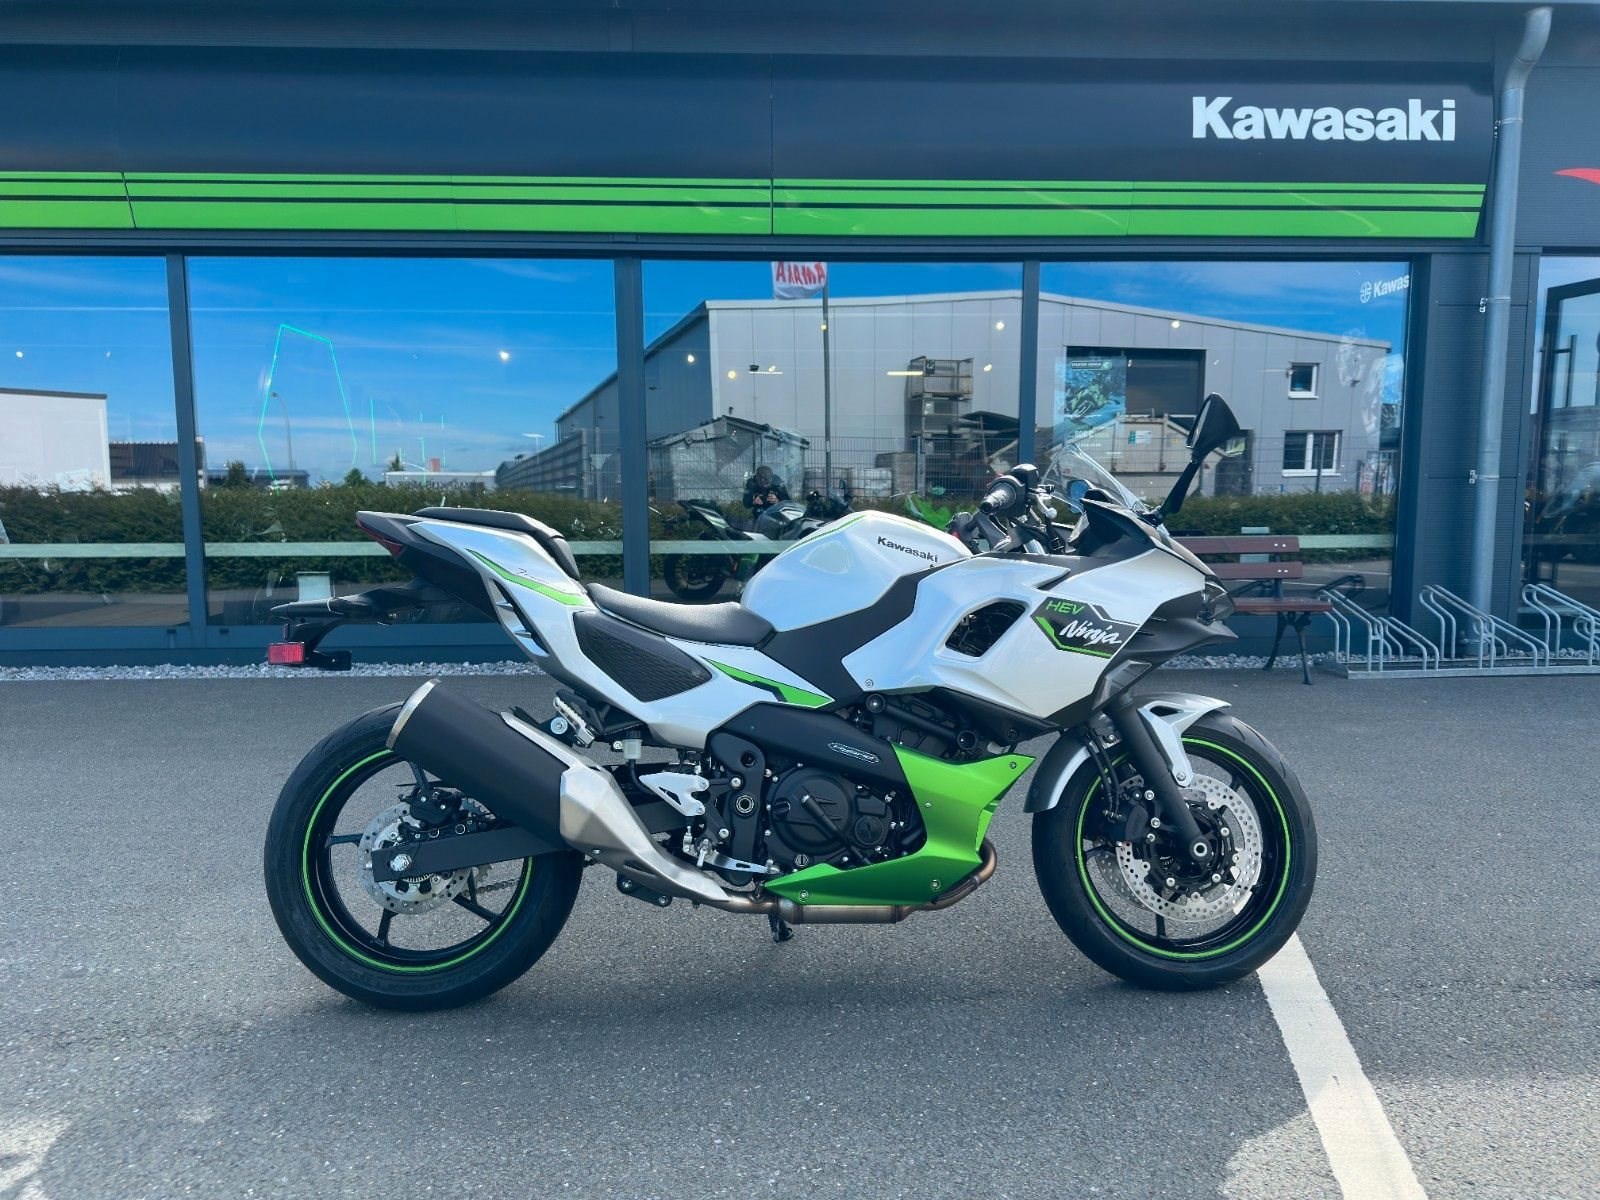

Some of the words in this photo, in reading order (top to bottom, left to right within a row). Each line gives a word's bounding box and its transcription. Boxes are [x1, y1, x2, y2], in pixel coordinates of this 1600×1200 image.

[1192, 96, 1455, 141] Kawasaki
[1373, 274, 1409, 298] Kawas
[877, 536, 938, 562] Kawasaki
[1045, 600, 1085, 615] HEV
[1059, 620, 1122, 646] Ninja
